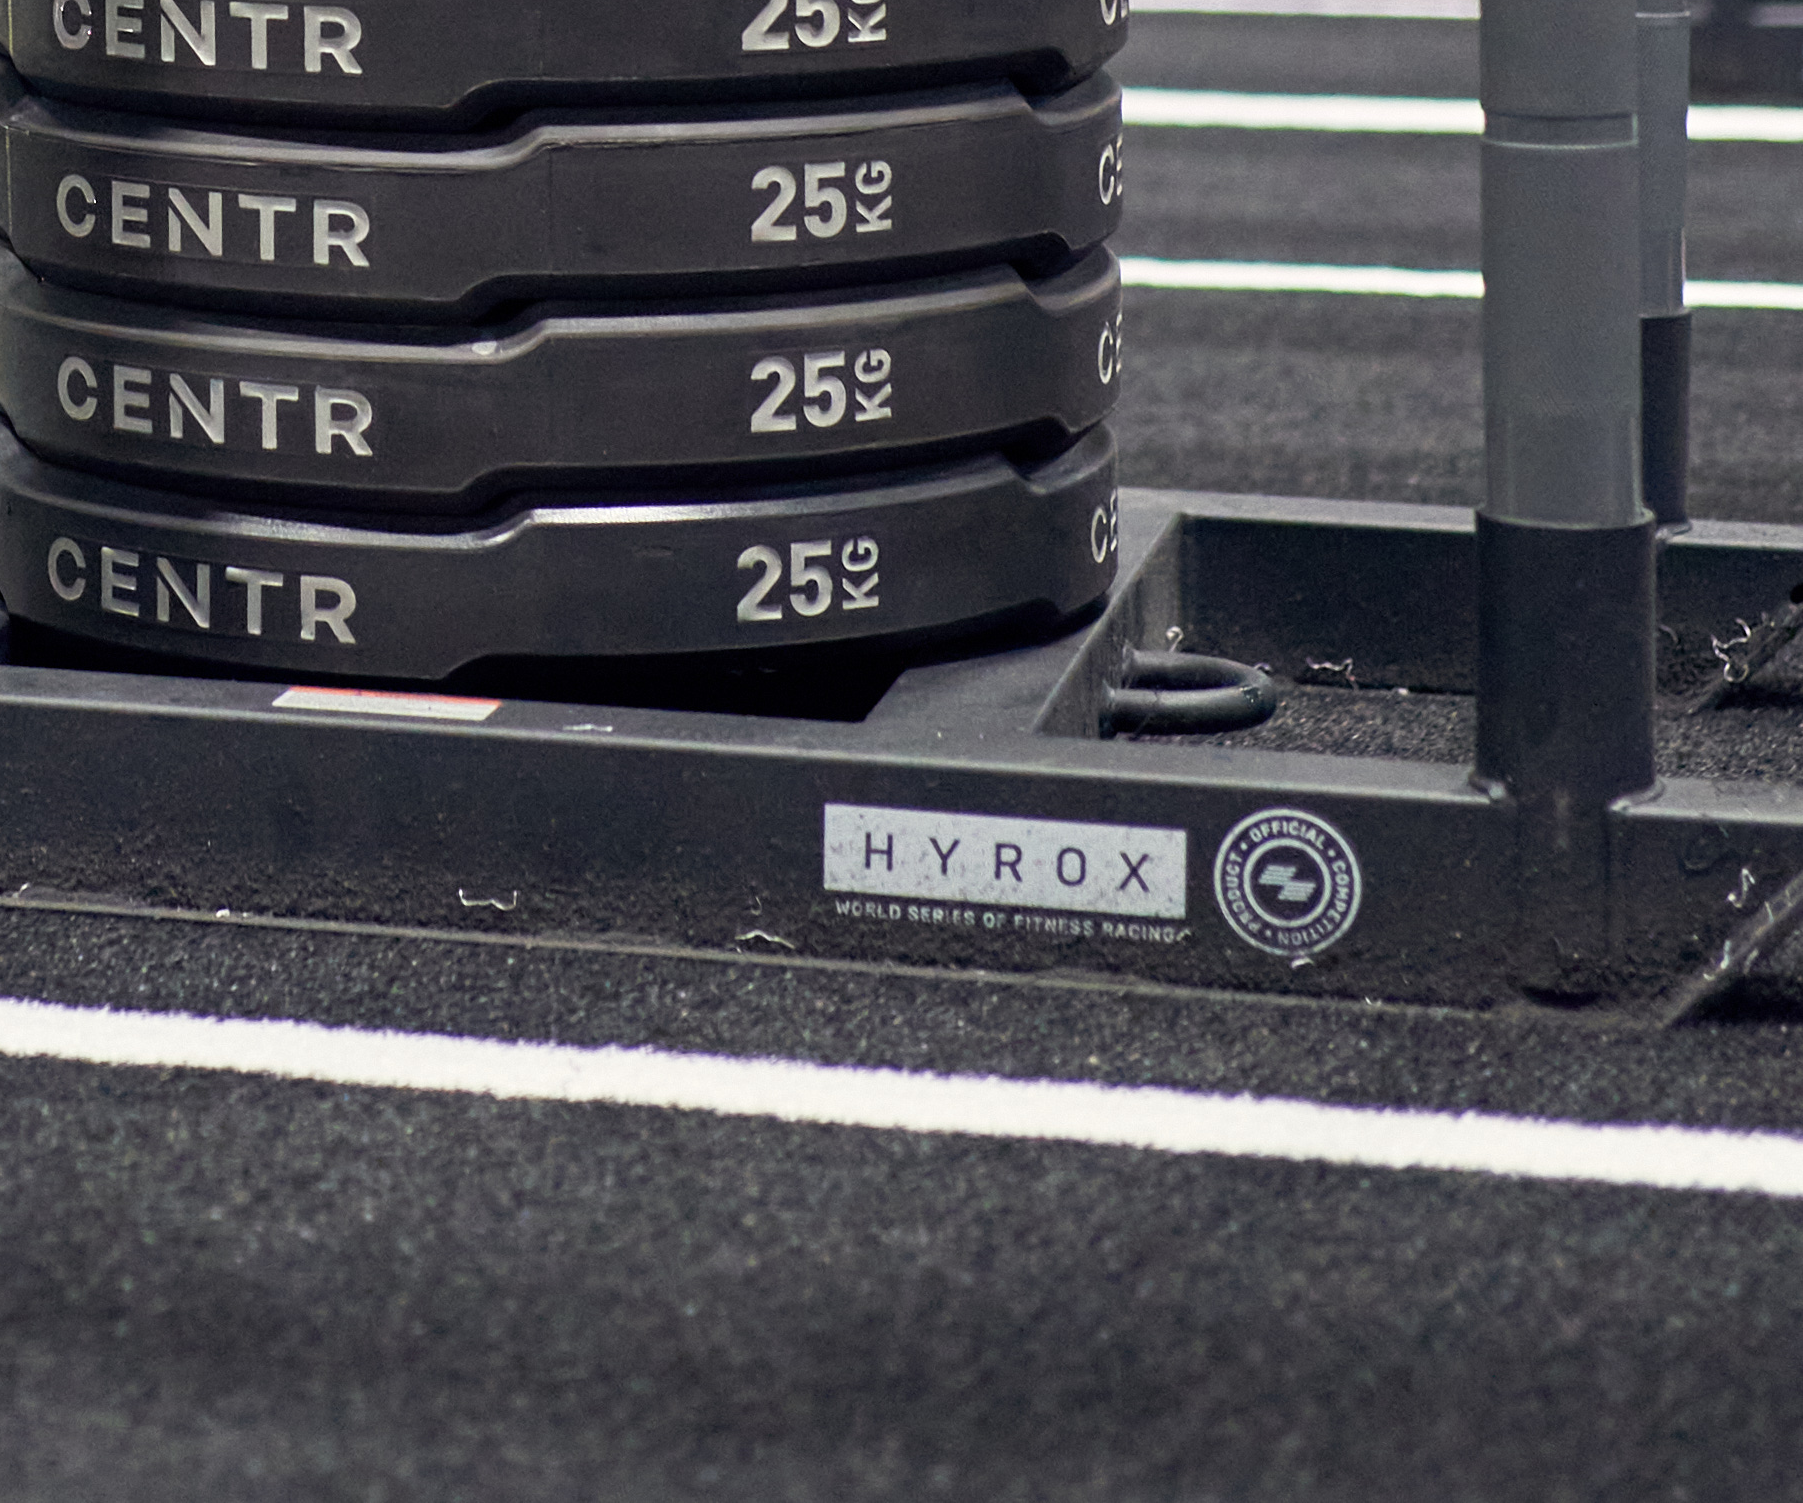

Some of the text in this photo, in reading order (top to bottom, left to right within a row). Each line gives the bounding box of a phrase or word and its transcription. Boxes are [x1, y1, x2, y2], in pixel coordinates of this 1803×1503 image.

[57, 176, 370, 267] CENTR
[58, 356, 374, 456] CENTR
[48, 538, 357, 644] CENTR
[864, 830, 1151, 893] HYROX
[1225, 820, 1350, 945] OFFICIAL COMPETITION PRODUCT
[835, 899, 1179, 944] WORLD SERIES OF FITNESS RACING
